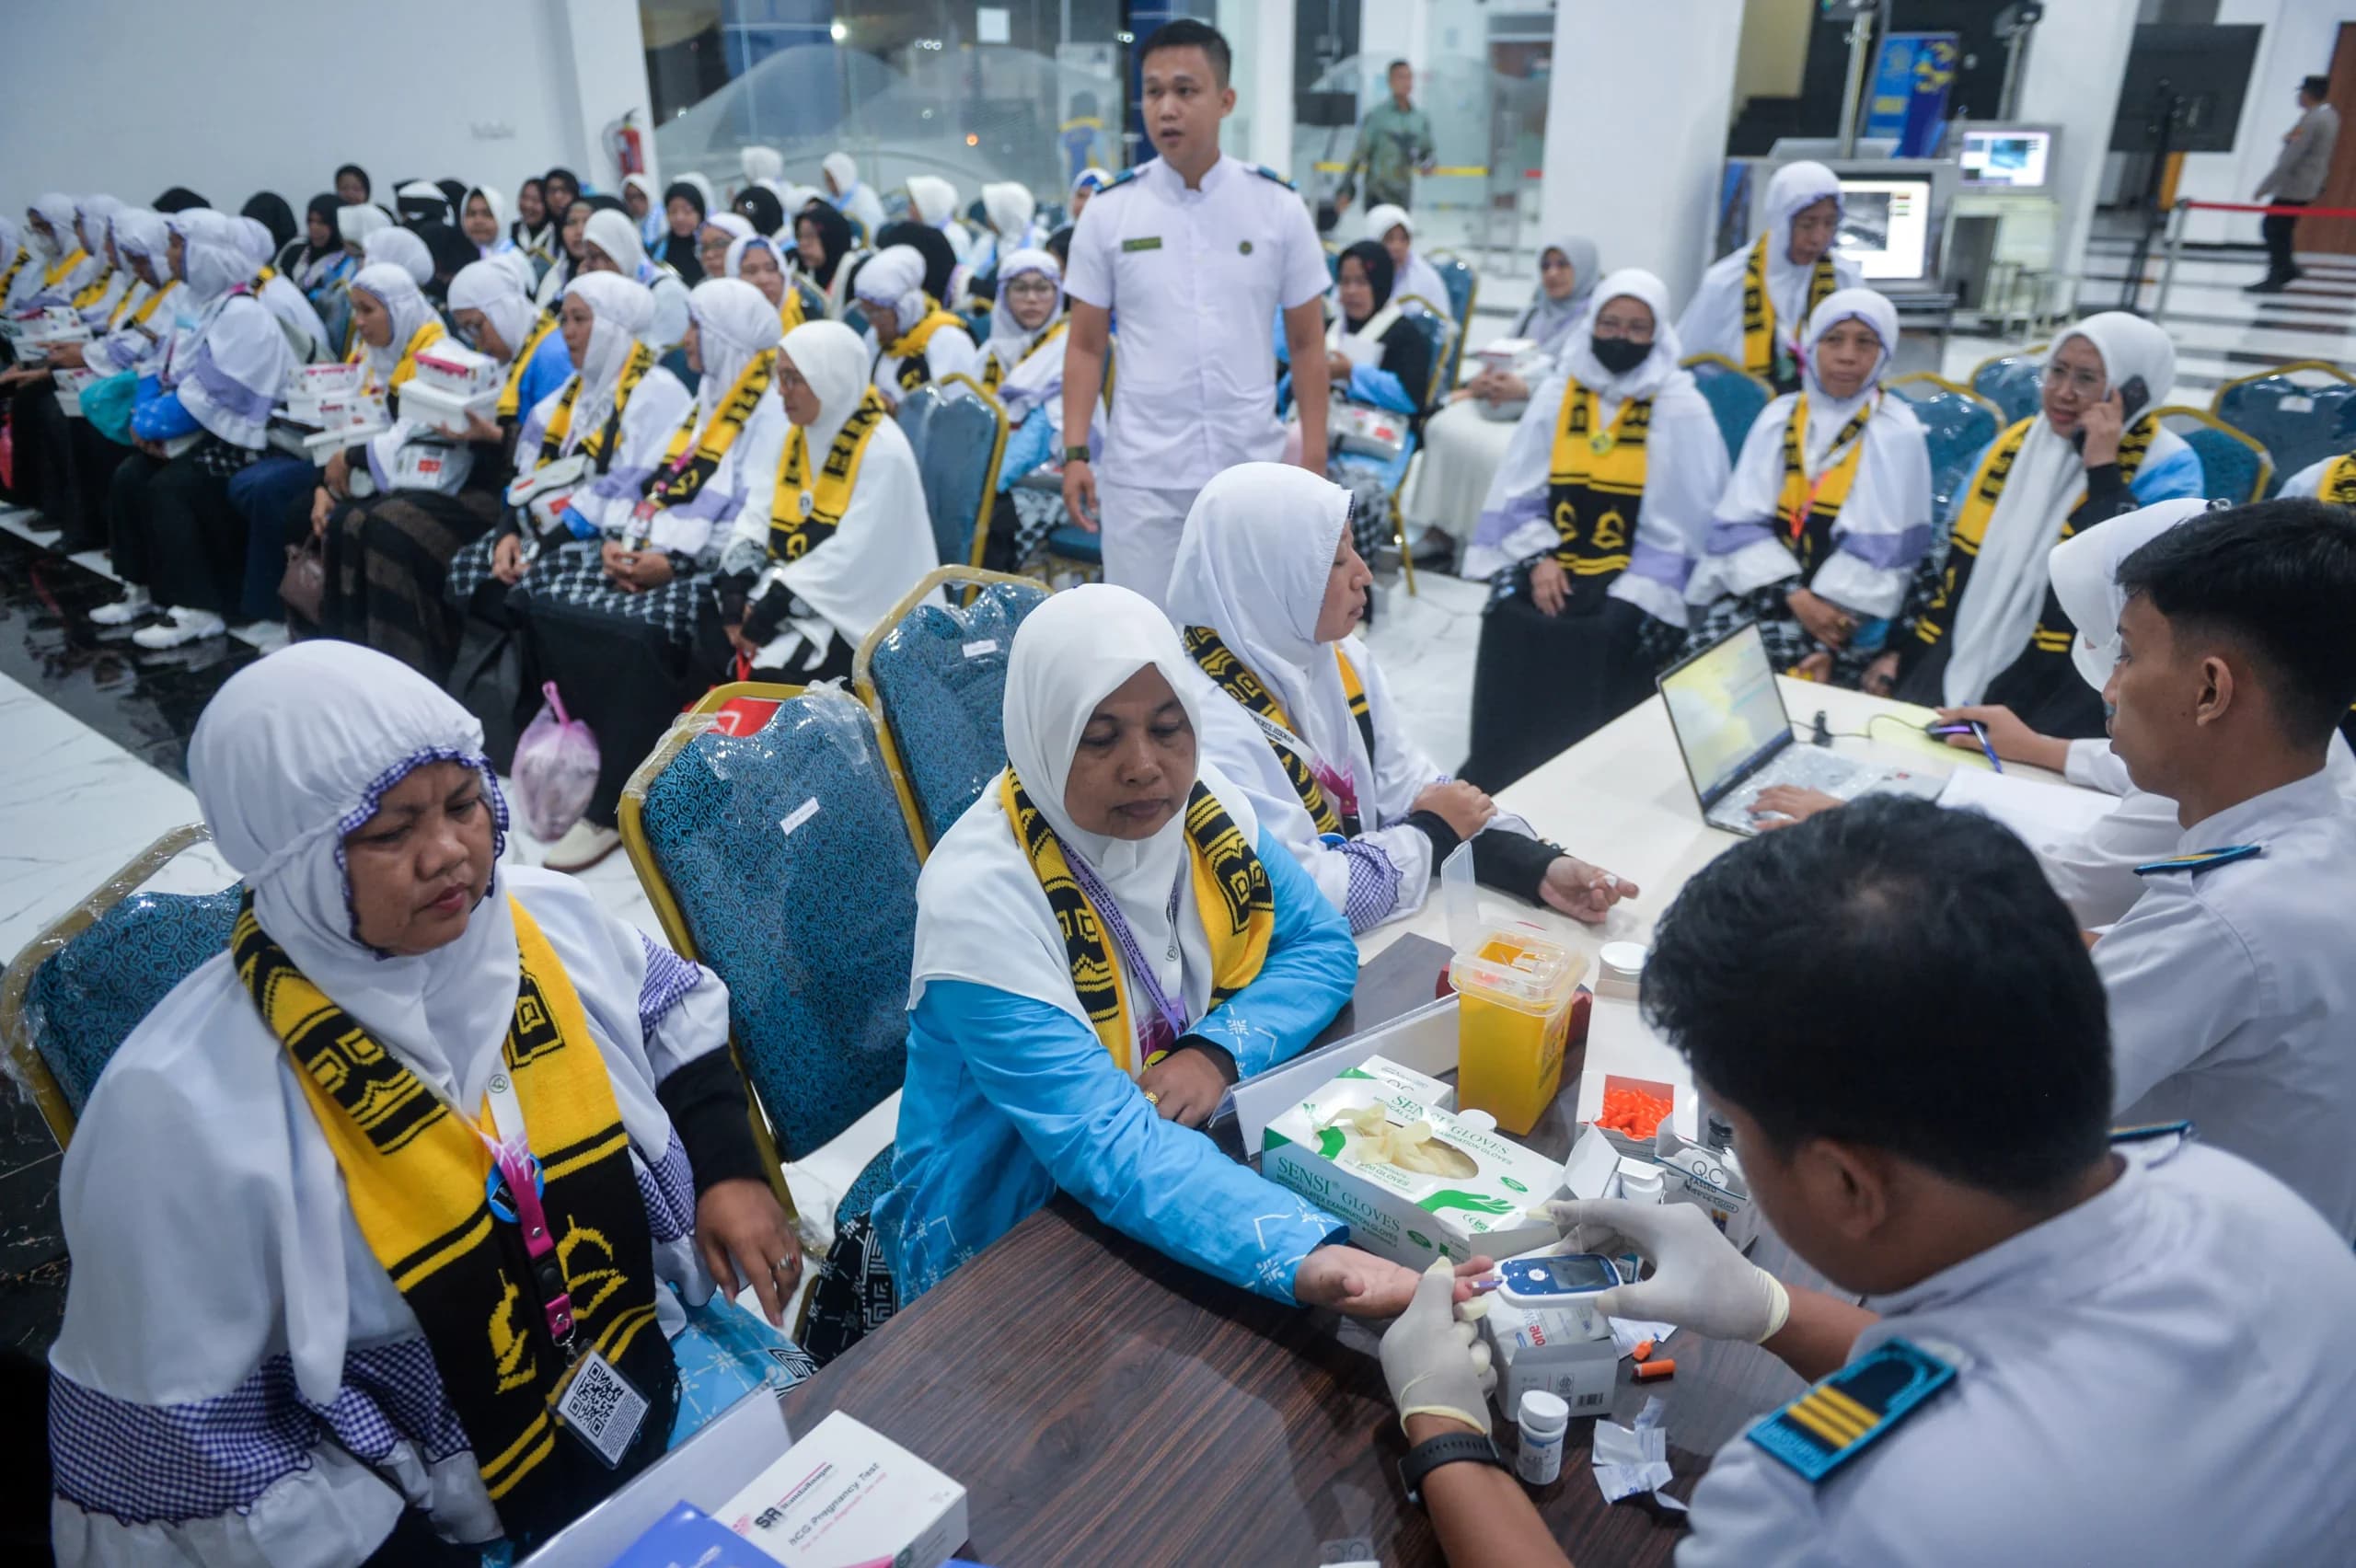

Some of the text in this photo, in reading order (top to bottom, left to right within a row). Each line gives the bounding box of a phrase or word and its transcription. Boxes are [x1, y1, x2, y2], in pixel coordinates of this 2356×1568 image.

[1088, 881, 1106, 904] TAHUN
[1450, 1125, 1509, 1155] GLOVES
[1277, 1156, 1332, 1195] SENSI
[1341, 1192, 1400, 1232] GLOVES
[810, 1482, 860, 1527] Pregnancy
[858, 1462, 880, 1482] Test
